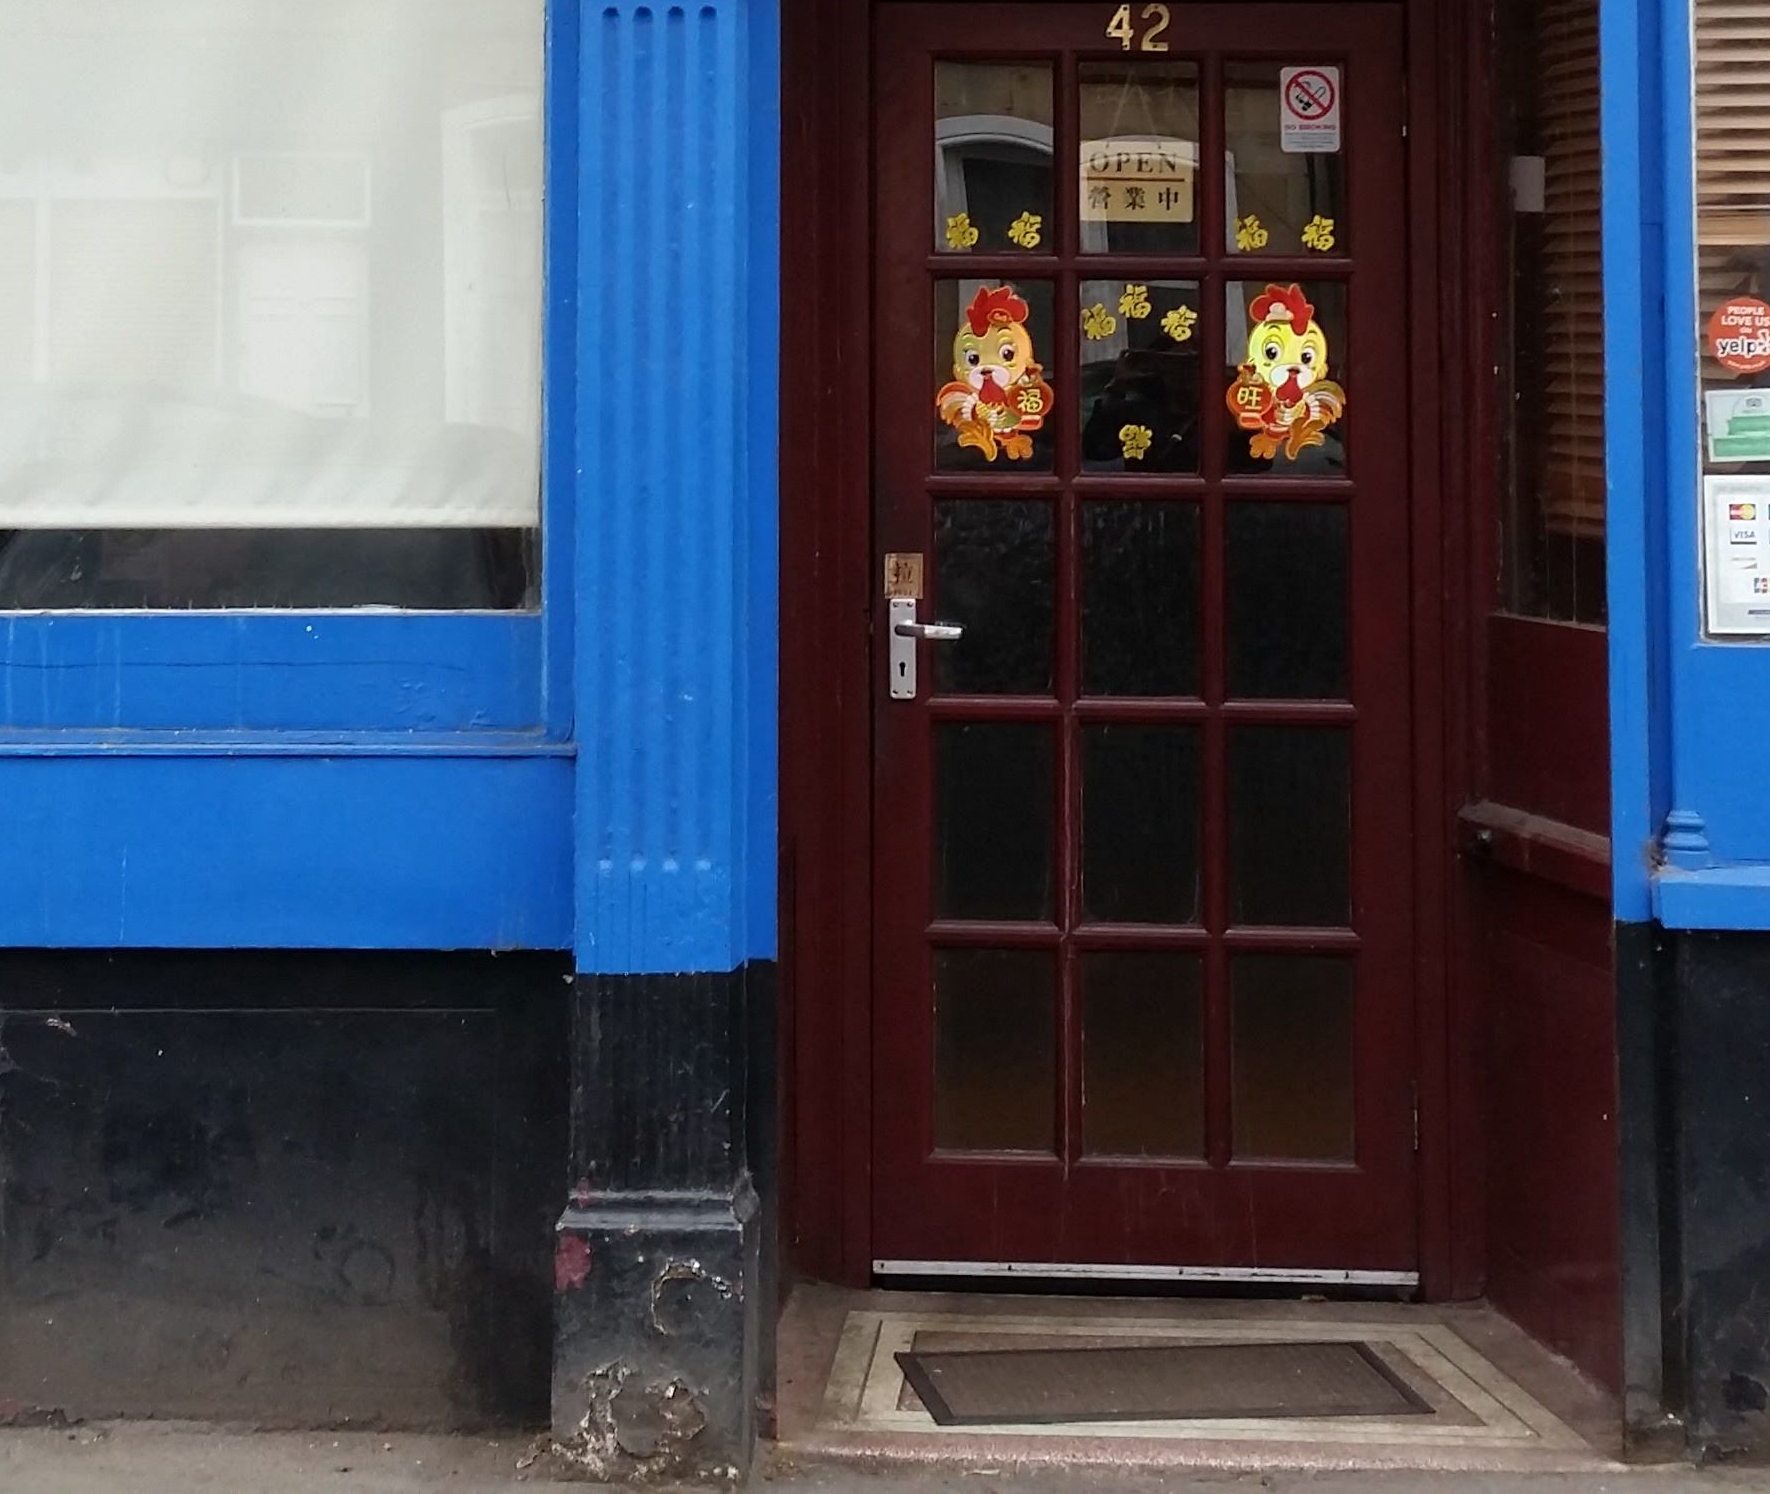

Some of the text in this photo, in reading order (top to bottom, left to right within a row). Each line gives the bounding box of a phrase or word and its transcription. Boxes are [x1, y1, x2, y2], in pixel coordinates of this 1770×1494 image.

[1105, 3, 1172, 52] 42
[1089, 152, 1177, 173] OPEN
[1727, 306, 1765, 316] PEOPLE
[1721, 316, 1770, 327] LOVE US
[1718, 338, 1758, 356] yelp
[1016, 387, 1044, 413] 福
[1235, 386, 1263, 410] 旺
[1734, 531, 1756, 539] VISA
